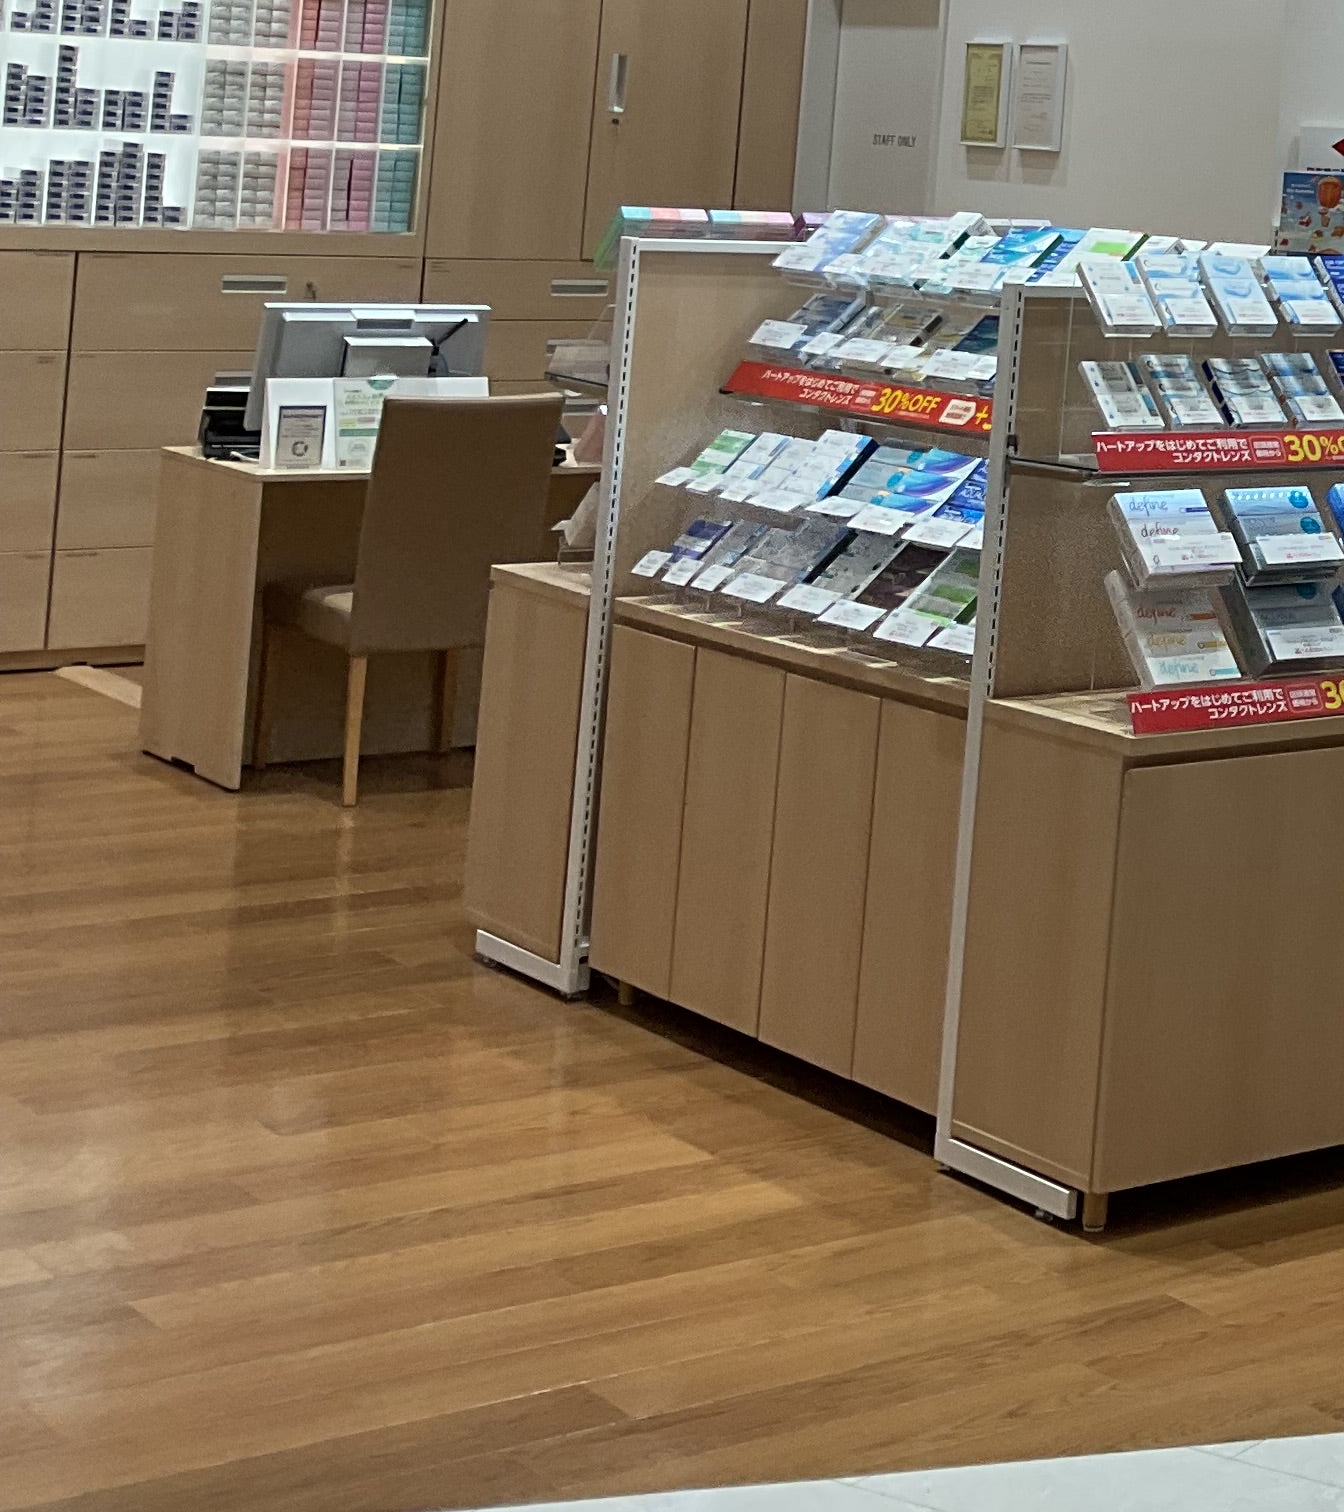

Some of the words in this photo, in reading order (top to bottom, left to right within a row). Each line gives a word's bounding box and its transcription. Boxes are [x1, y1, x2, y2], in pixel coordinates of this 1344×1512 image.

[798, 387, 853, 405] コンタクトレンズ
[870, 387, 942, 414] 30%OFF
[1096, 438, 1249, 453] ハートアップをはじめてご利用で
[1172, 450, 1251, 463] コンタクトレンズ
[1128, 494, 1169, 517] define
[1131, 688, 1285, 714] ハートアップをはじめてご利用で
[1208, 701, 1289, 720] コンタクトレンズ
